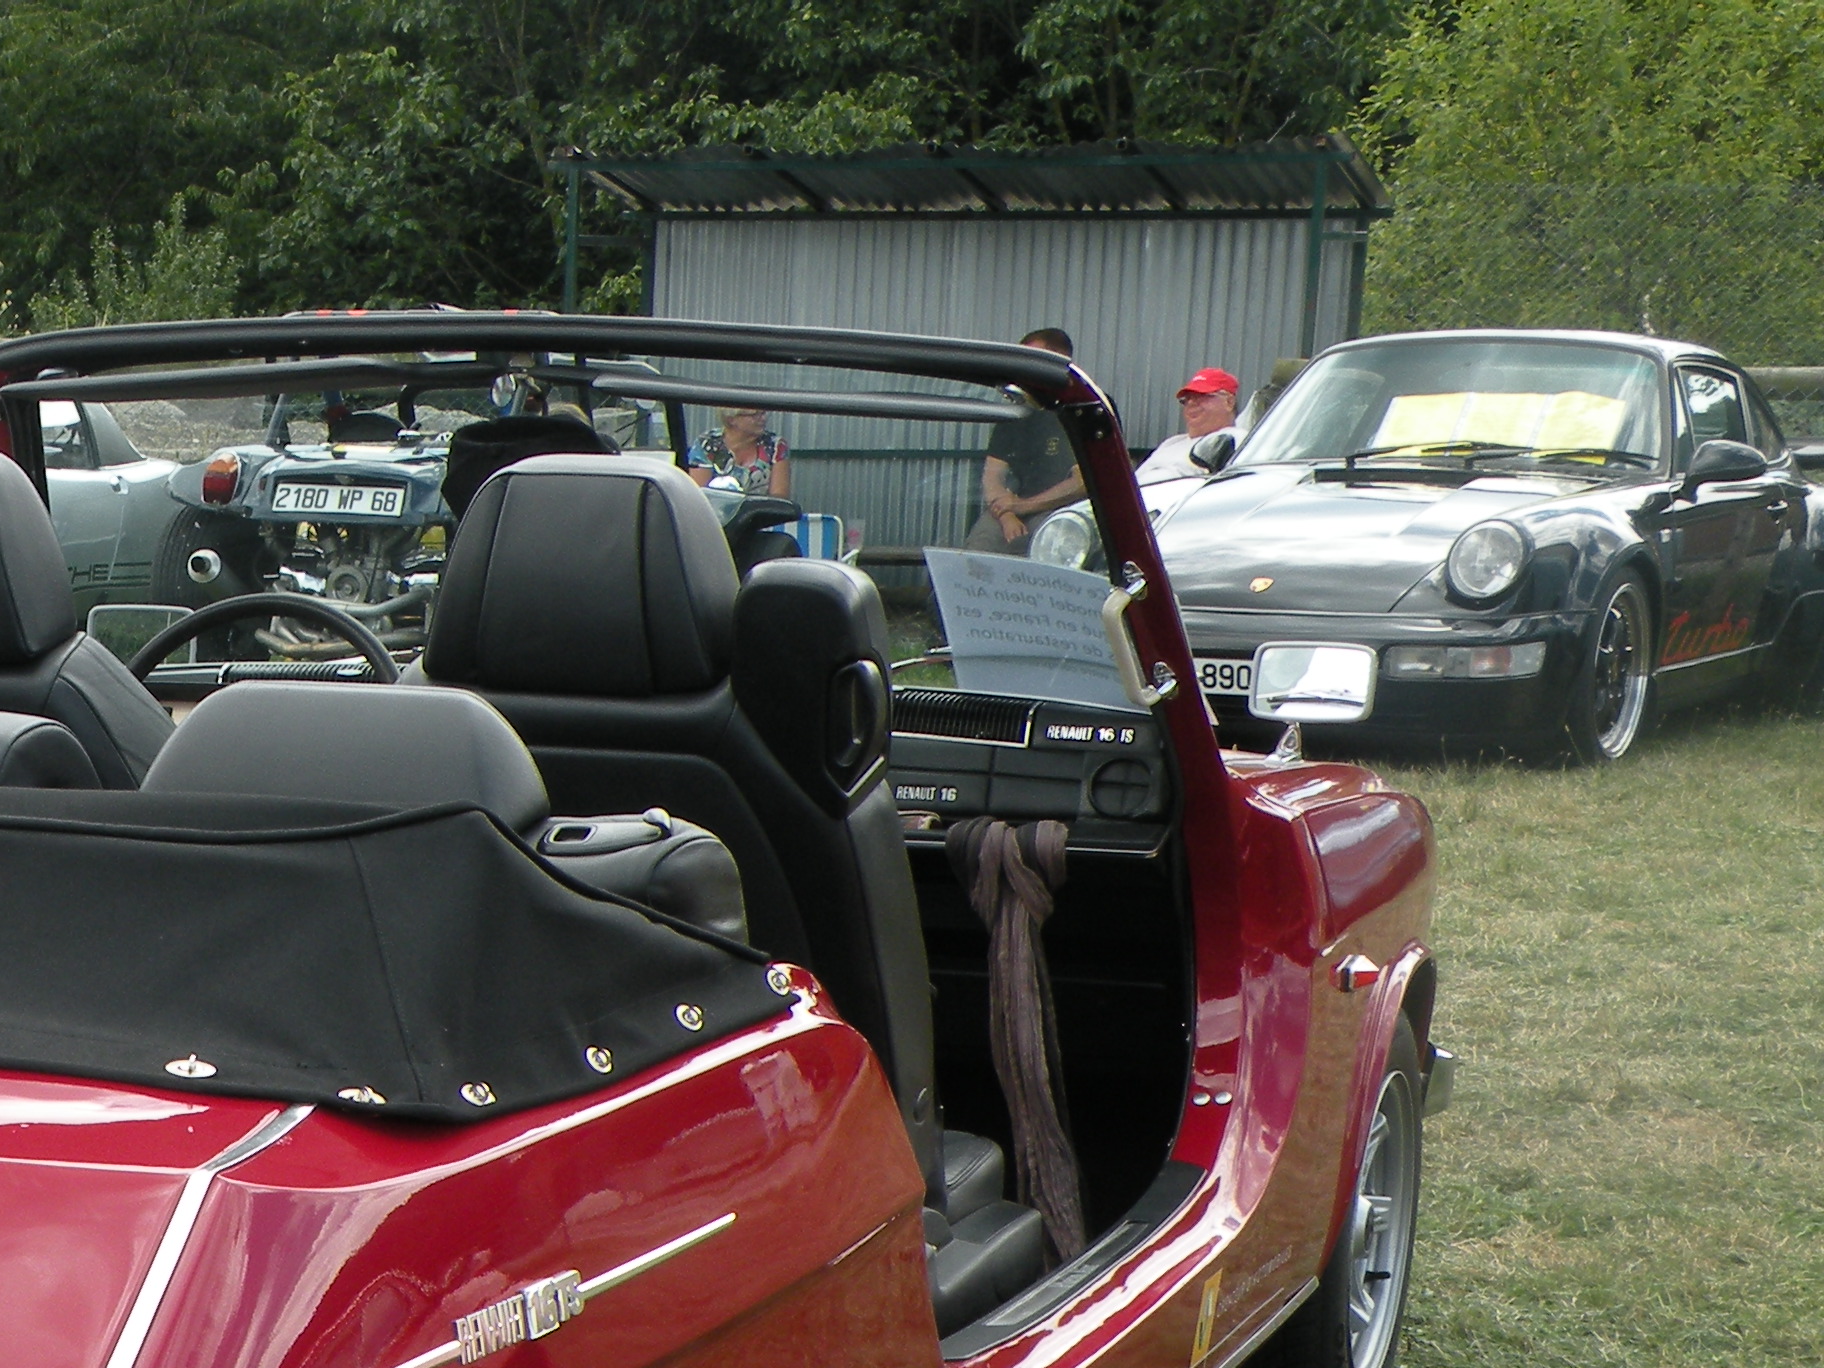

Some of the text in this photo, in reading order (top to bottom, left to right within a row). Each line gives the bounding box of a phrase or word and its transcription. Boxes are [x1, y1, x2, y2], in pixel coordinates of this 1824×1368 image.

[276, 488, 397, 512] 2180 WP 68
[1660, 603, 1750, 667] Turbo
[1047, 725, 1094, 741] RENAULT
[1098, 727, 1115, 742] 16
[896, 785, 957, 801] RENAULT 16
